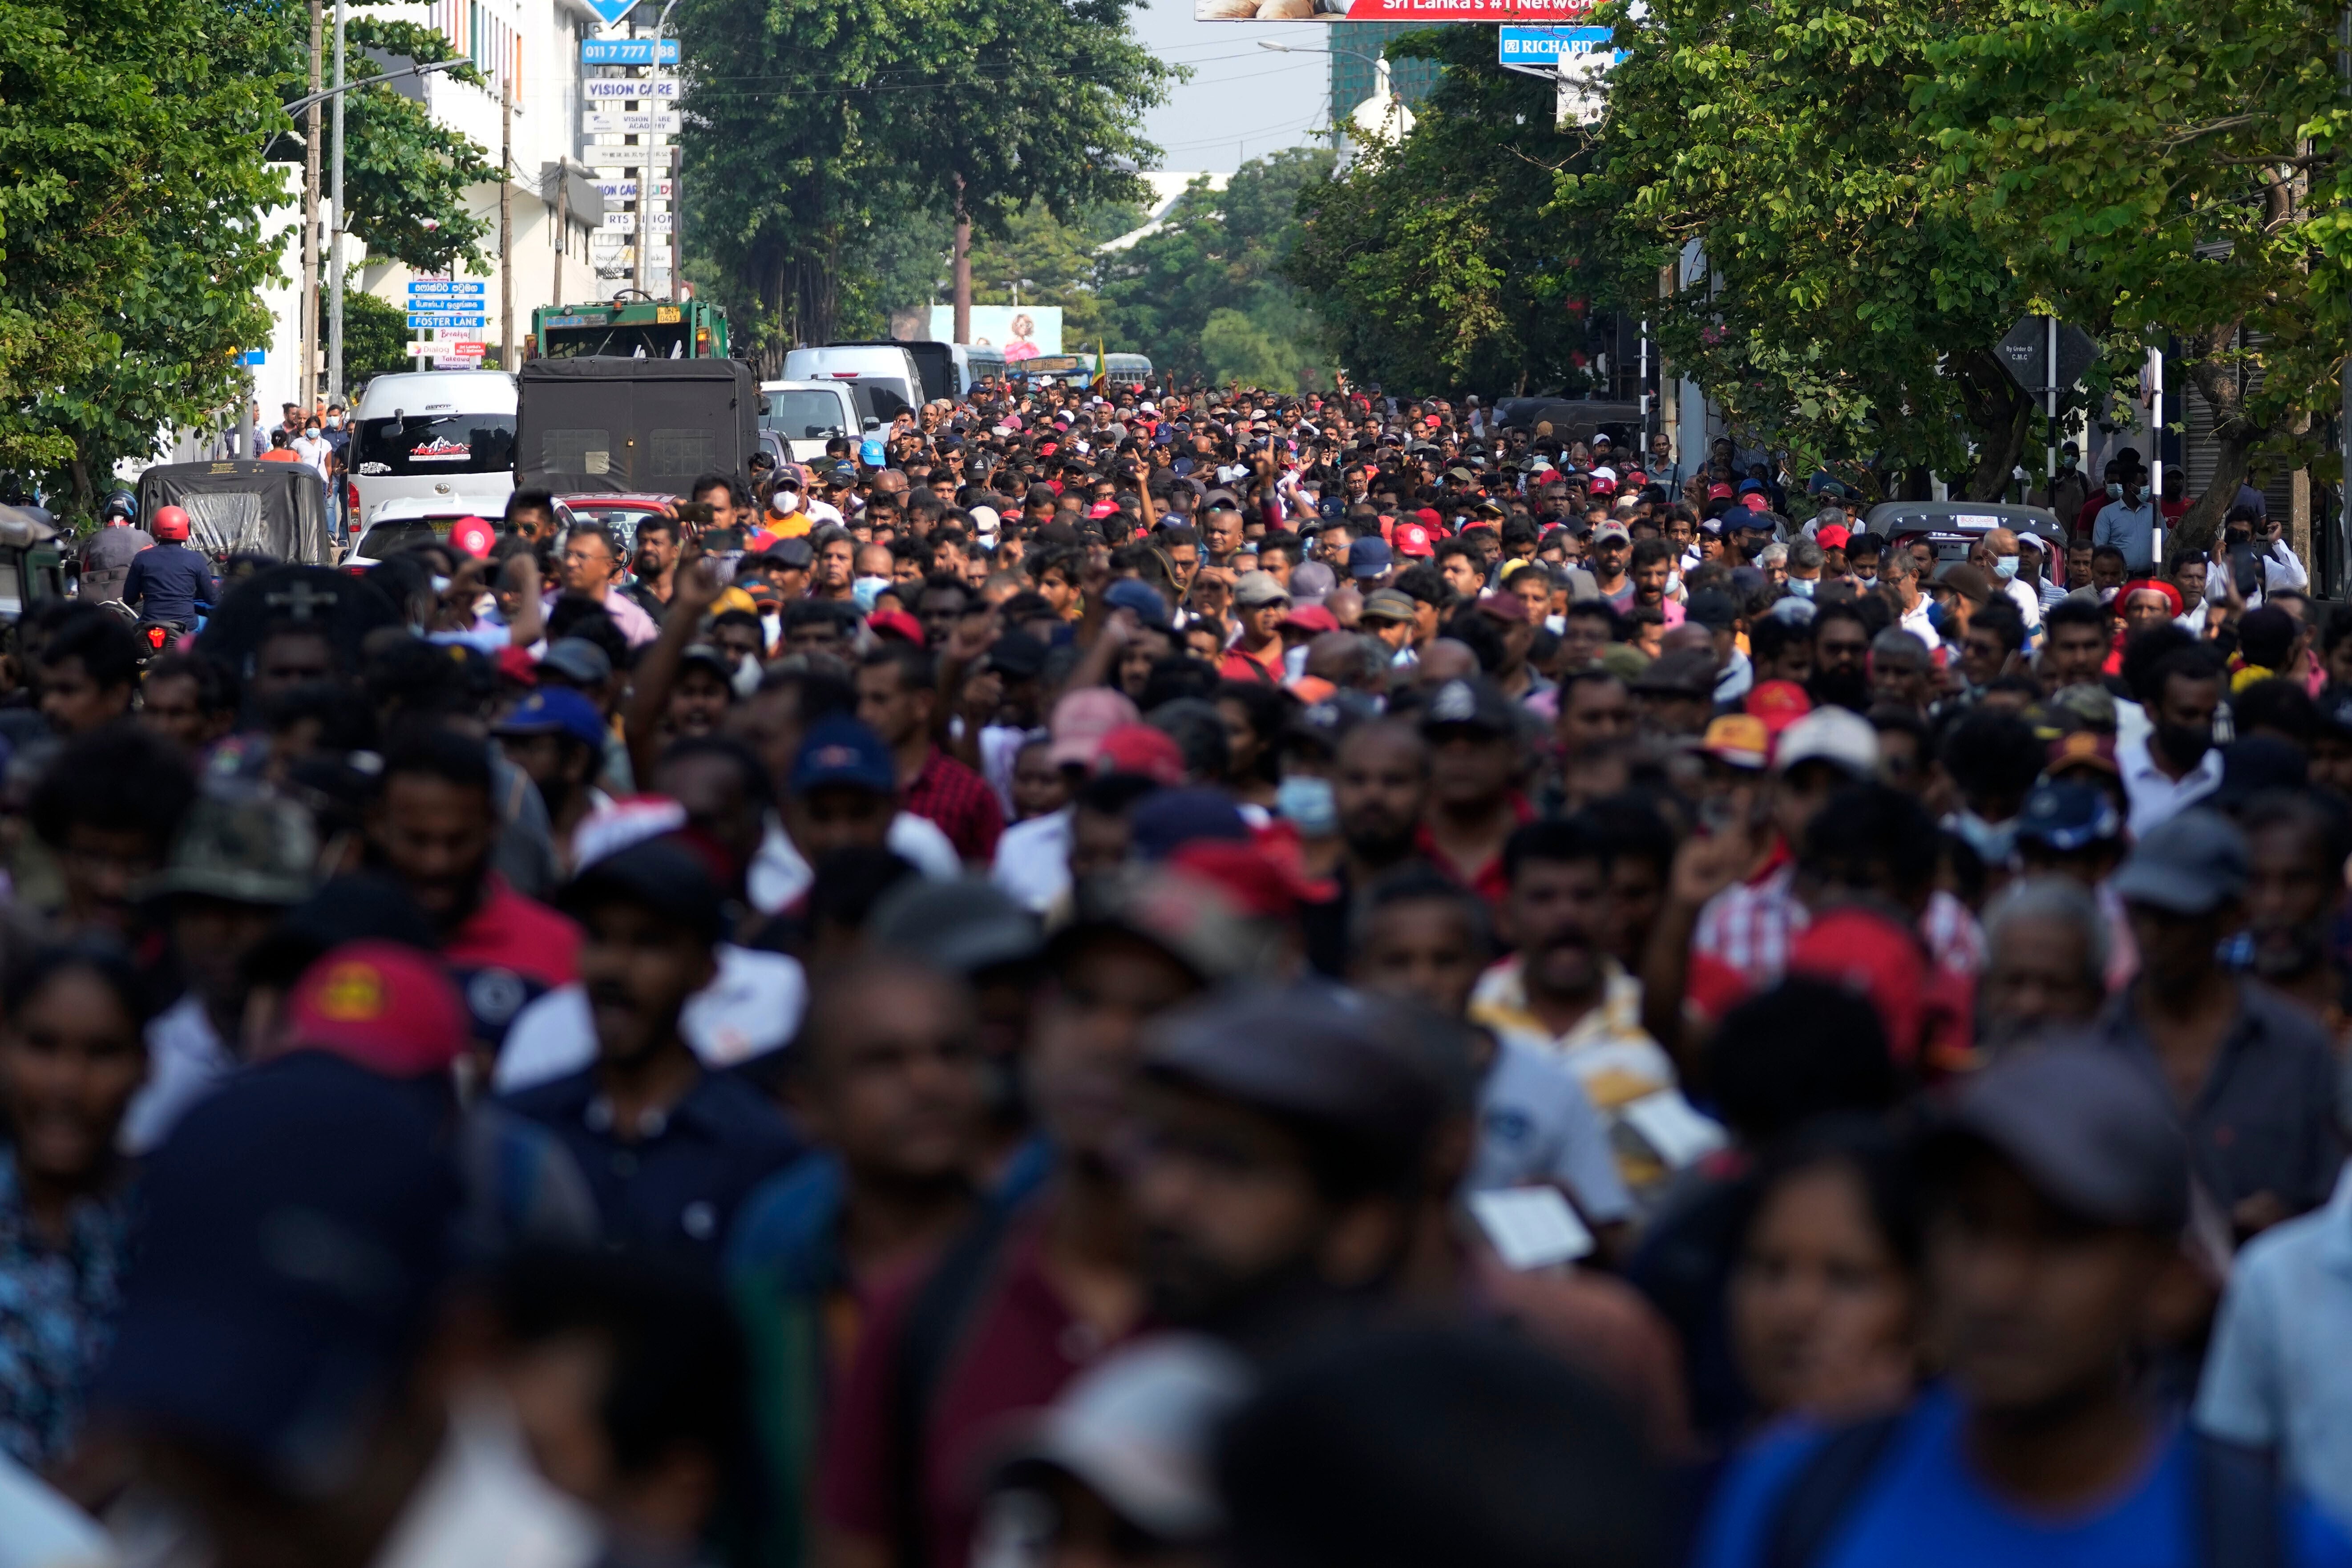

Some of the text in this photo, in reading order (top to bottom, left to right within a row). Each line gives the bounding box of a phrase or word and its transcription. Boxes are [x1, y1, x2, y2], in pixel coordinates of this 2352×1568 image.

[1383, 0, 1409, 9] Sri
[1414, 0, 1484, 9] Lanka's
[586, 46, 605, 57] 011
[610, 46, 617, 57] 7
[622, 45, 647, 57] 777
[590, 84, 634, 95] VISION
[416, 317, 477, 326] FOSTER LANE
[440, 329, 470, 339] Breakfa
[424, 346, 449, 354] Dialog
